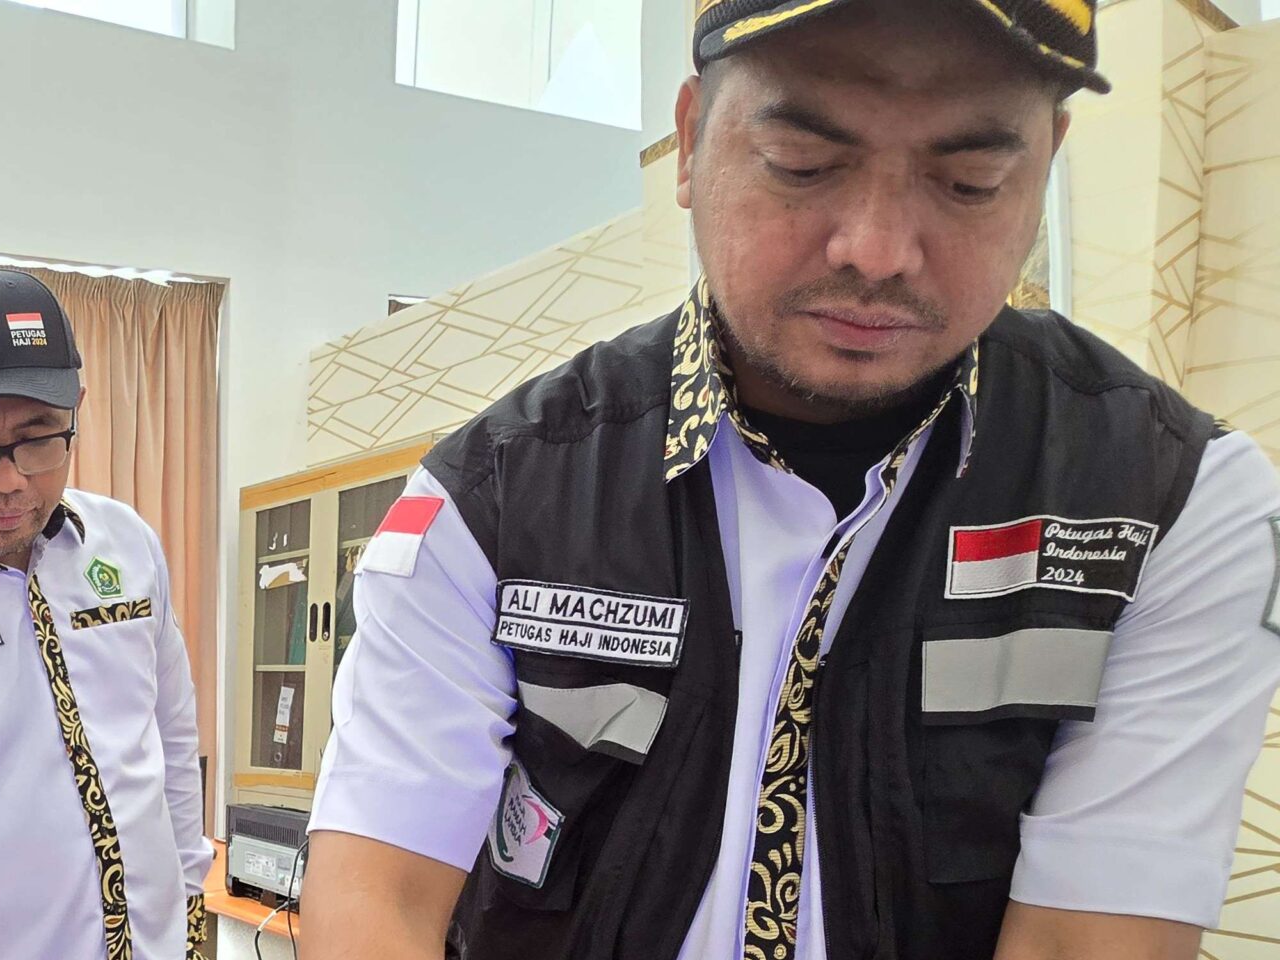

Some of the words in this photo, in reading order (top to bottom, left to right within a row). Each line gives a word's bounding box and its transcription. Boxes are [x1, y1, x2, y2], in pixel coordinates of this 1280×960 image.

[11, 330, 46, 338] PETUGAS
[13, 338, 31, 346] HAJI
[31, 337, 47, 346] 2024
[1044, 522, 1113, 542] Petugas
[1117, 524, 1151, 547] Haji
[1042, 542, 1127, 561] Indonesia
[1041, 566, 1085, 585] 2024
[507, 589, 540, 613] ALI
[549, 592, 676, 629] MACHZUMI
[499, 620, 552, 642] PETUGAS
[559, 629, 593, 648] HAJI
[598, 635, 672, 657] INDONESIA
